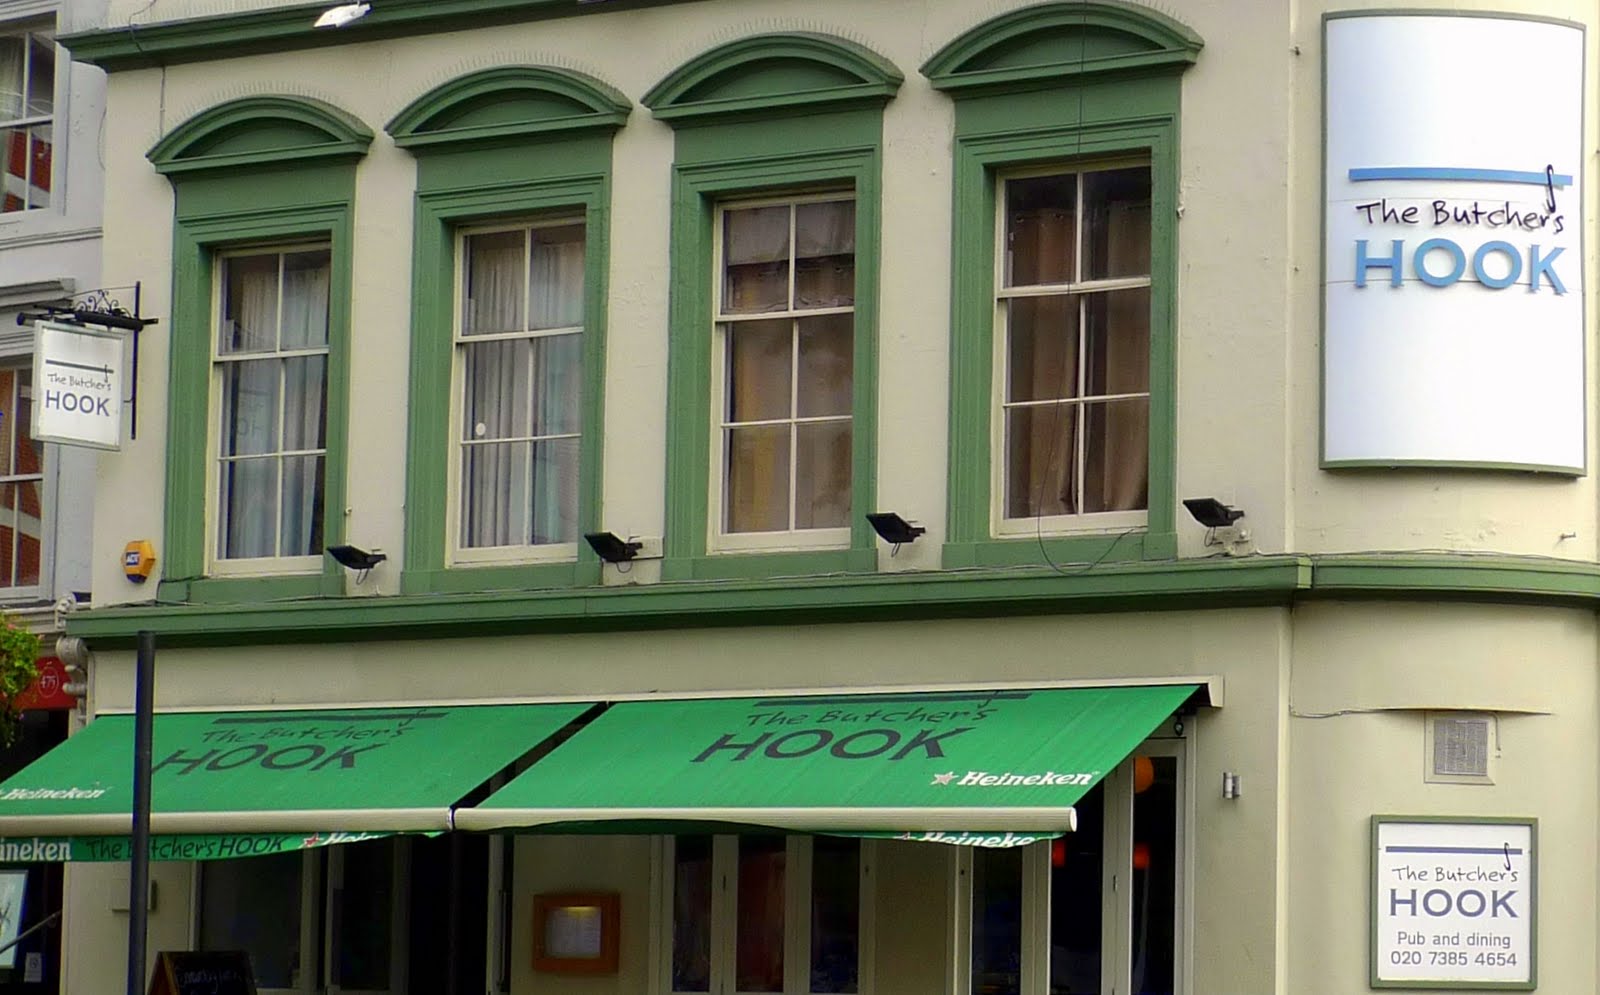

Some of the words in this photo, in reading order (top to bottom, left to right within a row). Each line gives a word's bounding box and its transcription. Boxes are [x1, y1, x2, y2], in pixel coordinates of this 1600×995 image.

[1356, 198, 1419, 225] The
[1354, 238, 1568, 295] HOOK
[47, 373, 67, 386] The
[45, 389, 110, 417] HOOK
[747, 711, 804, 726] The
[202, 728, 254, 744] The
[689, 727, 976, 763] HOOK
[150, 743, 388, 776] HOOK
[957, 770, 1093, 787] Heineken
[2, 787, 105, 800] Heineken
[86, 836, 121, 860] The
[218, 836, 290, 857] HOOK
[1392, 865, 1428, 882] The
[1389, 888, 1519, 918] HOOK
[1397, 931, 1425, 945] Pub
[1432, 932, 1460, 946] and
[1466, 932, 1511, 949] dining
[1391, 951, 1422, 965] 020
[1428, 951, 1468, 966] 7385
[1474, 953, 1517, 967] 4654
